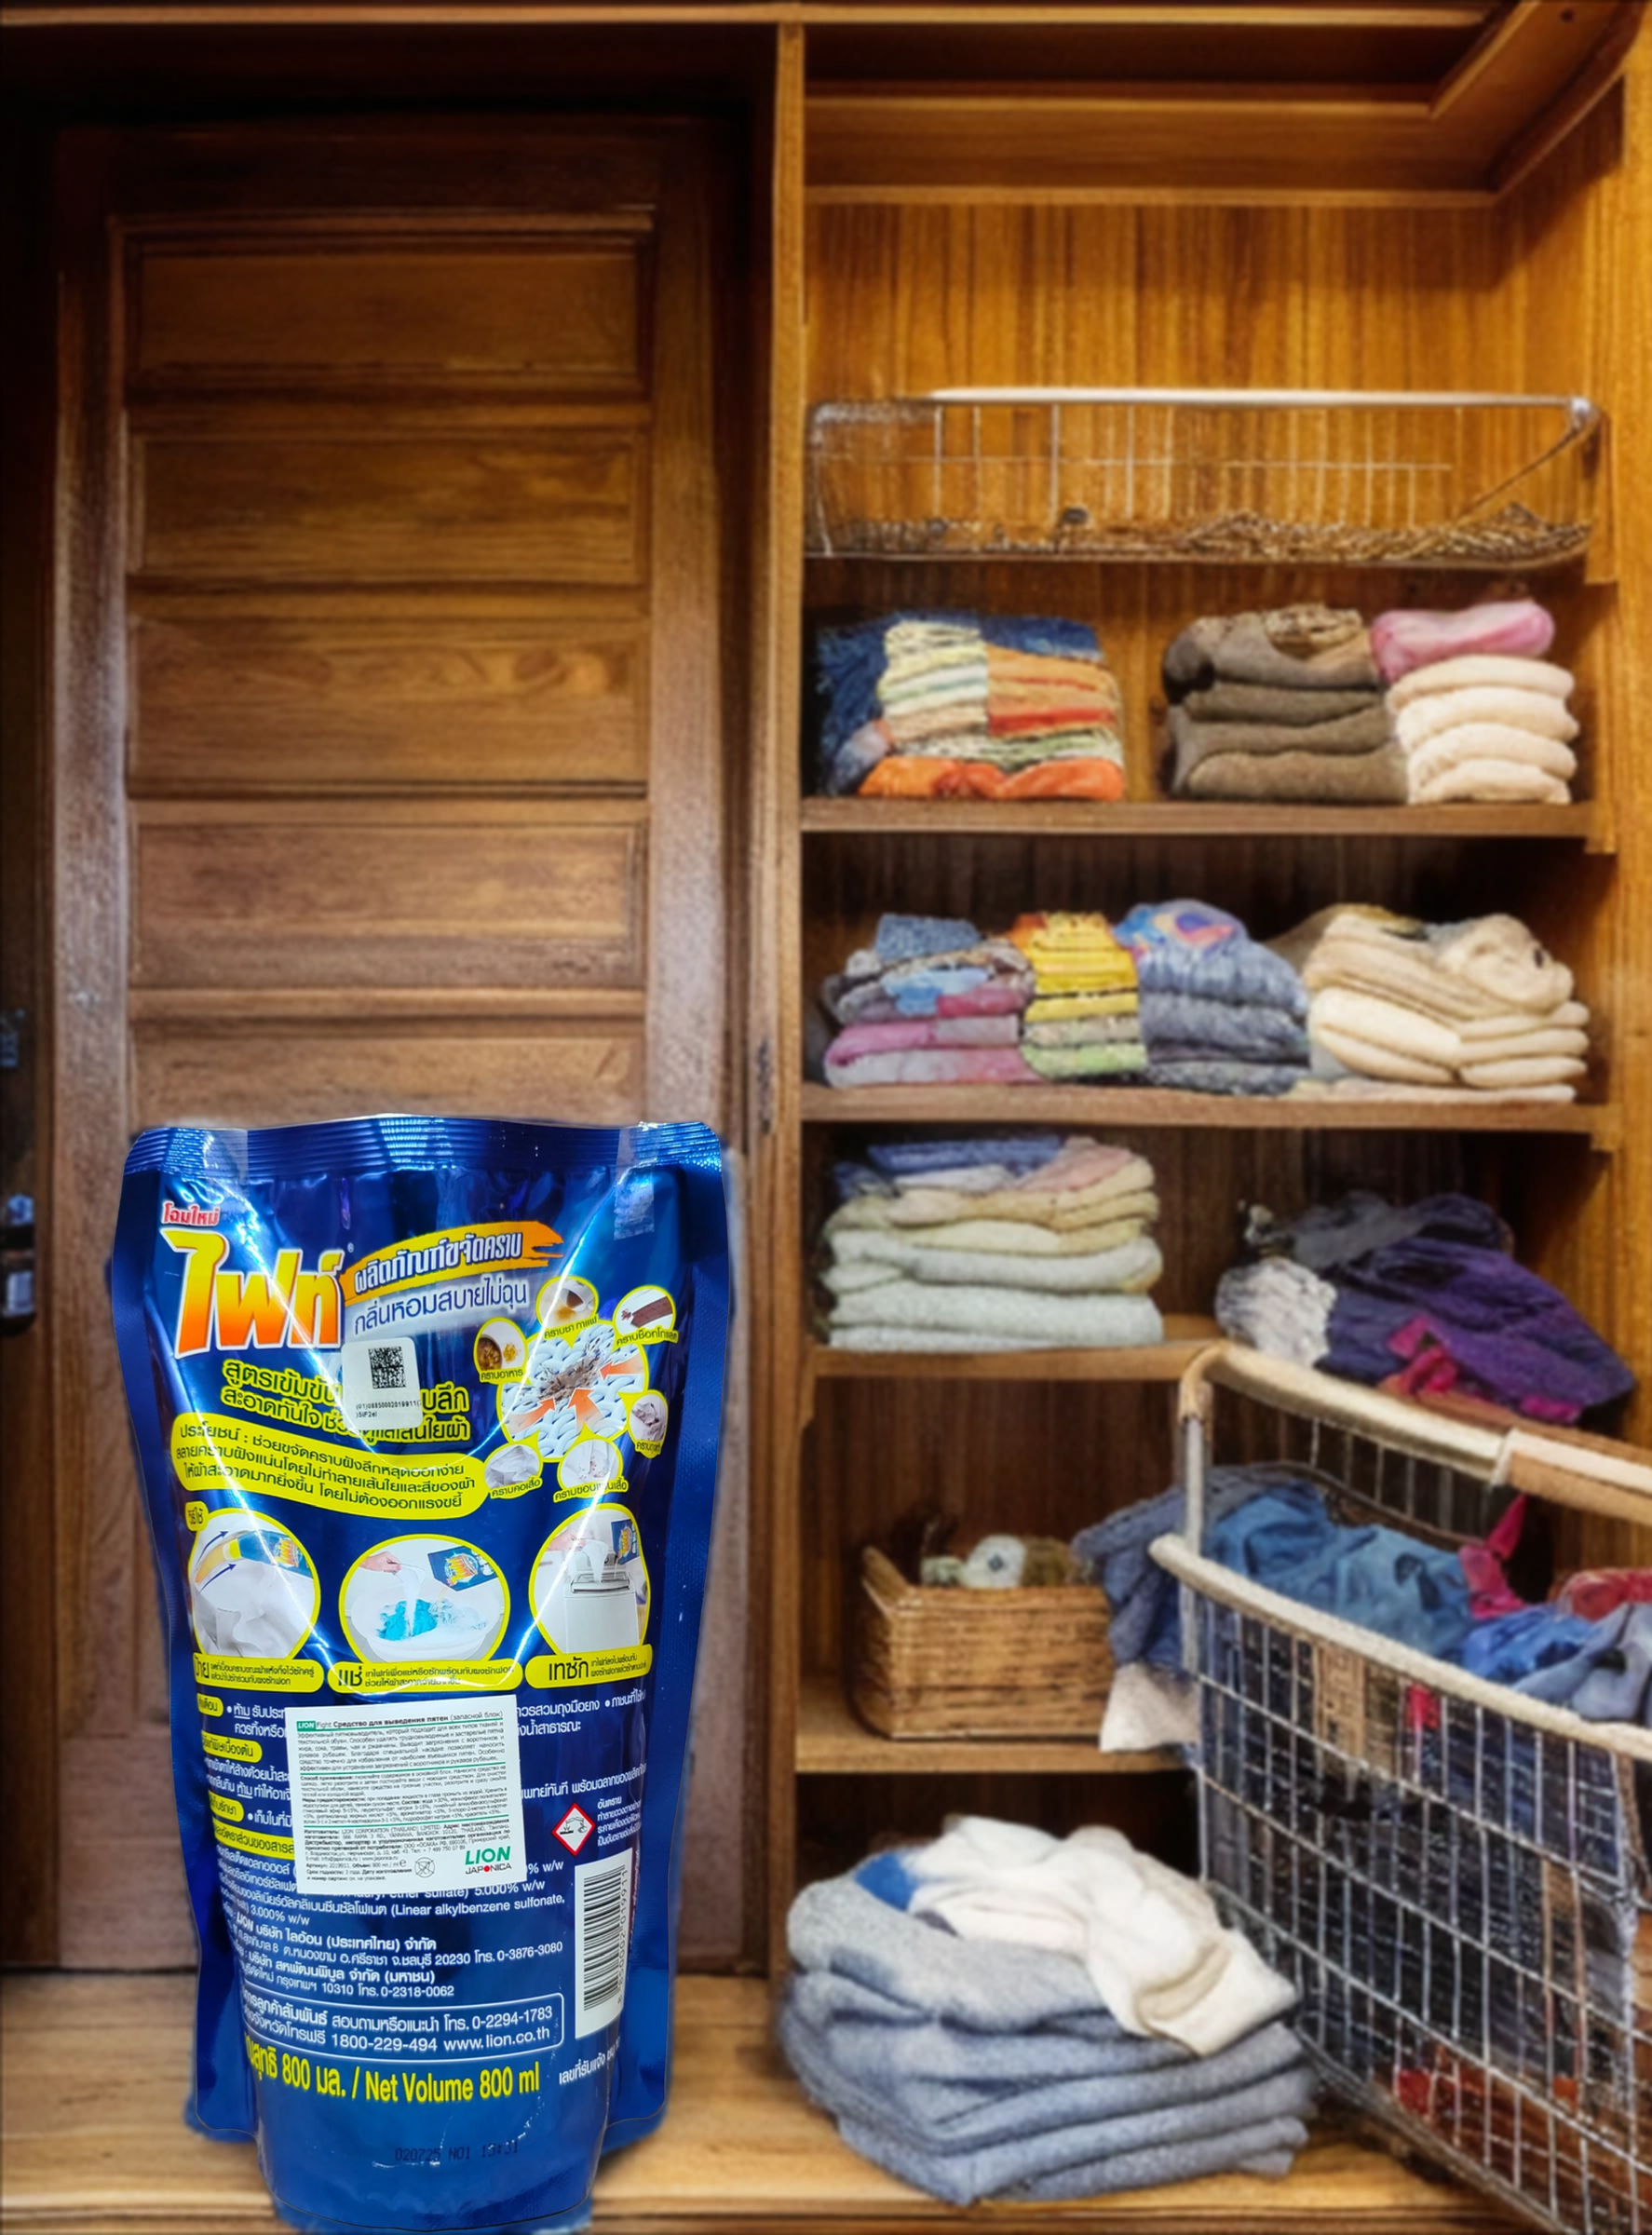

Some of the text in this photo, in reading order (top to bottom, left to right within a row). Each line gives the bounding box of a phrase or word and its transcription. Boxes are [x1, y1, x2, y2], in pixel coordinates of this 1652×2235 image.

[162, 1201, 221, 1226] โฉมใหม่
[354, 1232, 523, 1294] ผลิตภัณฑ์ขจัดคราบ
[160, 1227, 345, 1360] ไฟท์
[355, 1277, 527, 1335] กลิ่นหอมสบายไม่ฉุน
[221, 1386, 322, 1429] สะอาดทันใจ
[548, 1656, 589, 1681] เทซัก
[385, 1717, 425, 1727] выведения
[465, 1846, 511, 1865] LION
[542, 1860, 564, 1872] w/w
[522, 1879, 546, 1892] w/w
[391, 1903, 432, 1917] (Linear
[435, 1902, 510, 1917] alkylbenzene
[288, 1914, 310, 1926] w/w
[326, 1935, 400, 1953] (ประเทศไทย)
[404, 1936, 437, 1951] จำกัด
[435, 1952, 471, 1966] 20230
[497, 1941, 563, 1962] 0-3876-3080
[349, 1967, 380, 1982] จำกัด
[385, 1970, 436, 1984] (มหาชน)
[321, 1983, 354, 1996] 10310
[380, 1985, 454, 1998] 0-2318-0062
[332, 2013, 440, 2032] สอบถามหรือแนะนำ
[443, 2013, 469, 2032] โทร.
[472, 2005, 552, 2030] 0-2294-1783
[332, 2033, 438, 2052] 1800-229-494
[281, 2052, 311, 2091] 800
[316, 2065, 346, 2097] มล.
[365, 2070, 399, 2103] Net
[402, 2071, 474, 2104] Volume
[480, 2066, 513, 2100] 800
[519, 2061, 540, 2094] ml
